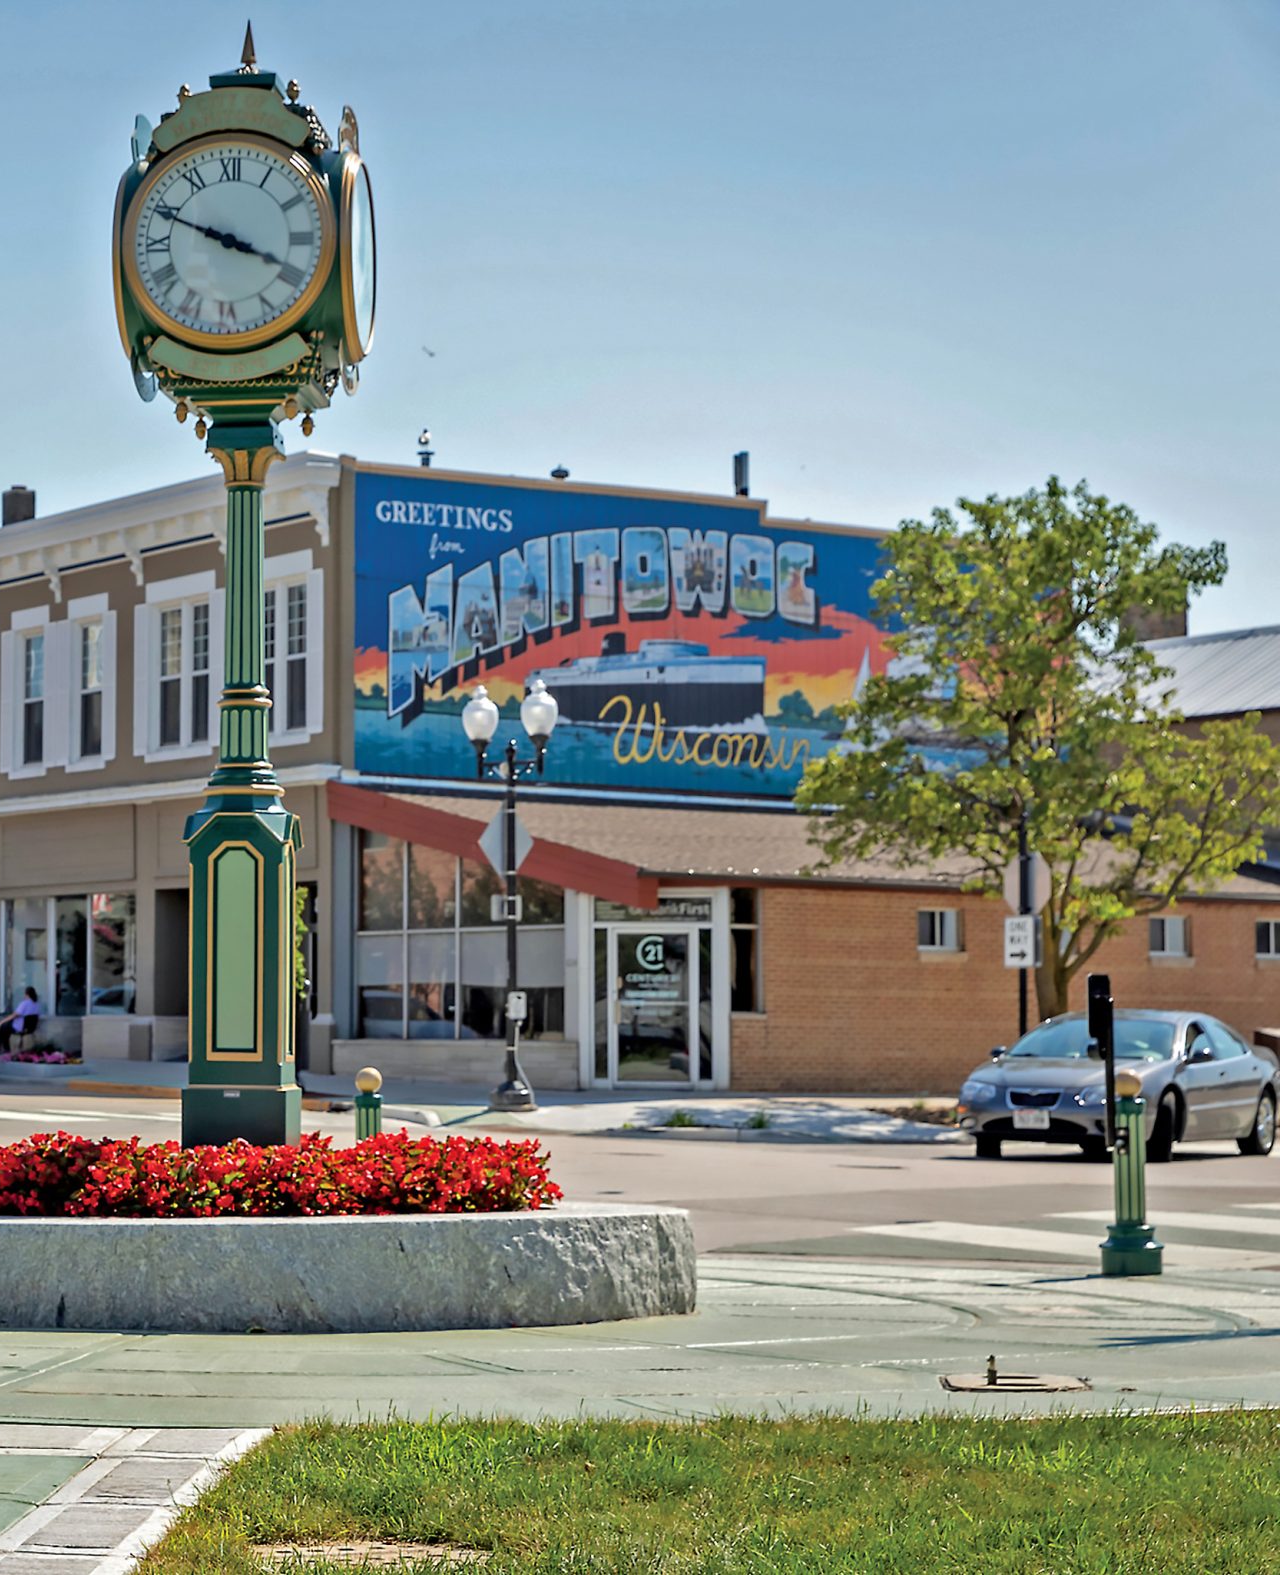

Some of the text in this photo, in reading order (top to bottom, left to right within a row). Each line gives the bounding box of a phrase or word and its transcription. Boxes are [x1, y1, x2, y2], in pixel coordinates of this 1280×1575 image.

[182, 167, 206, 195] XI
[219, 157, 241, 182] XII
[374, 500, 514, 533] GREETINGS
[428, 532, 465, 560] from
[387, 526, 817, 718] MANITOWOC
[598, 694, 810, 770] Wisconsin
